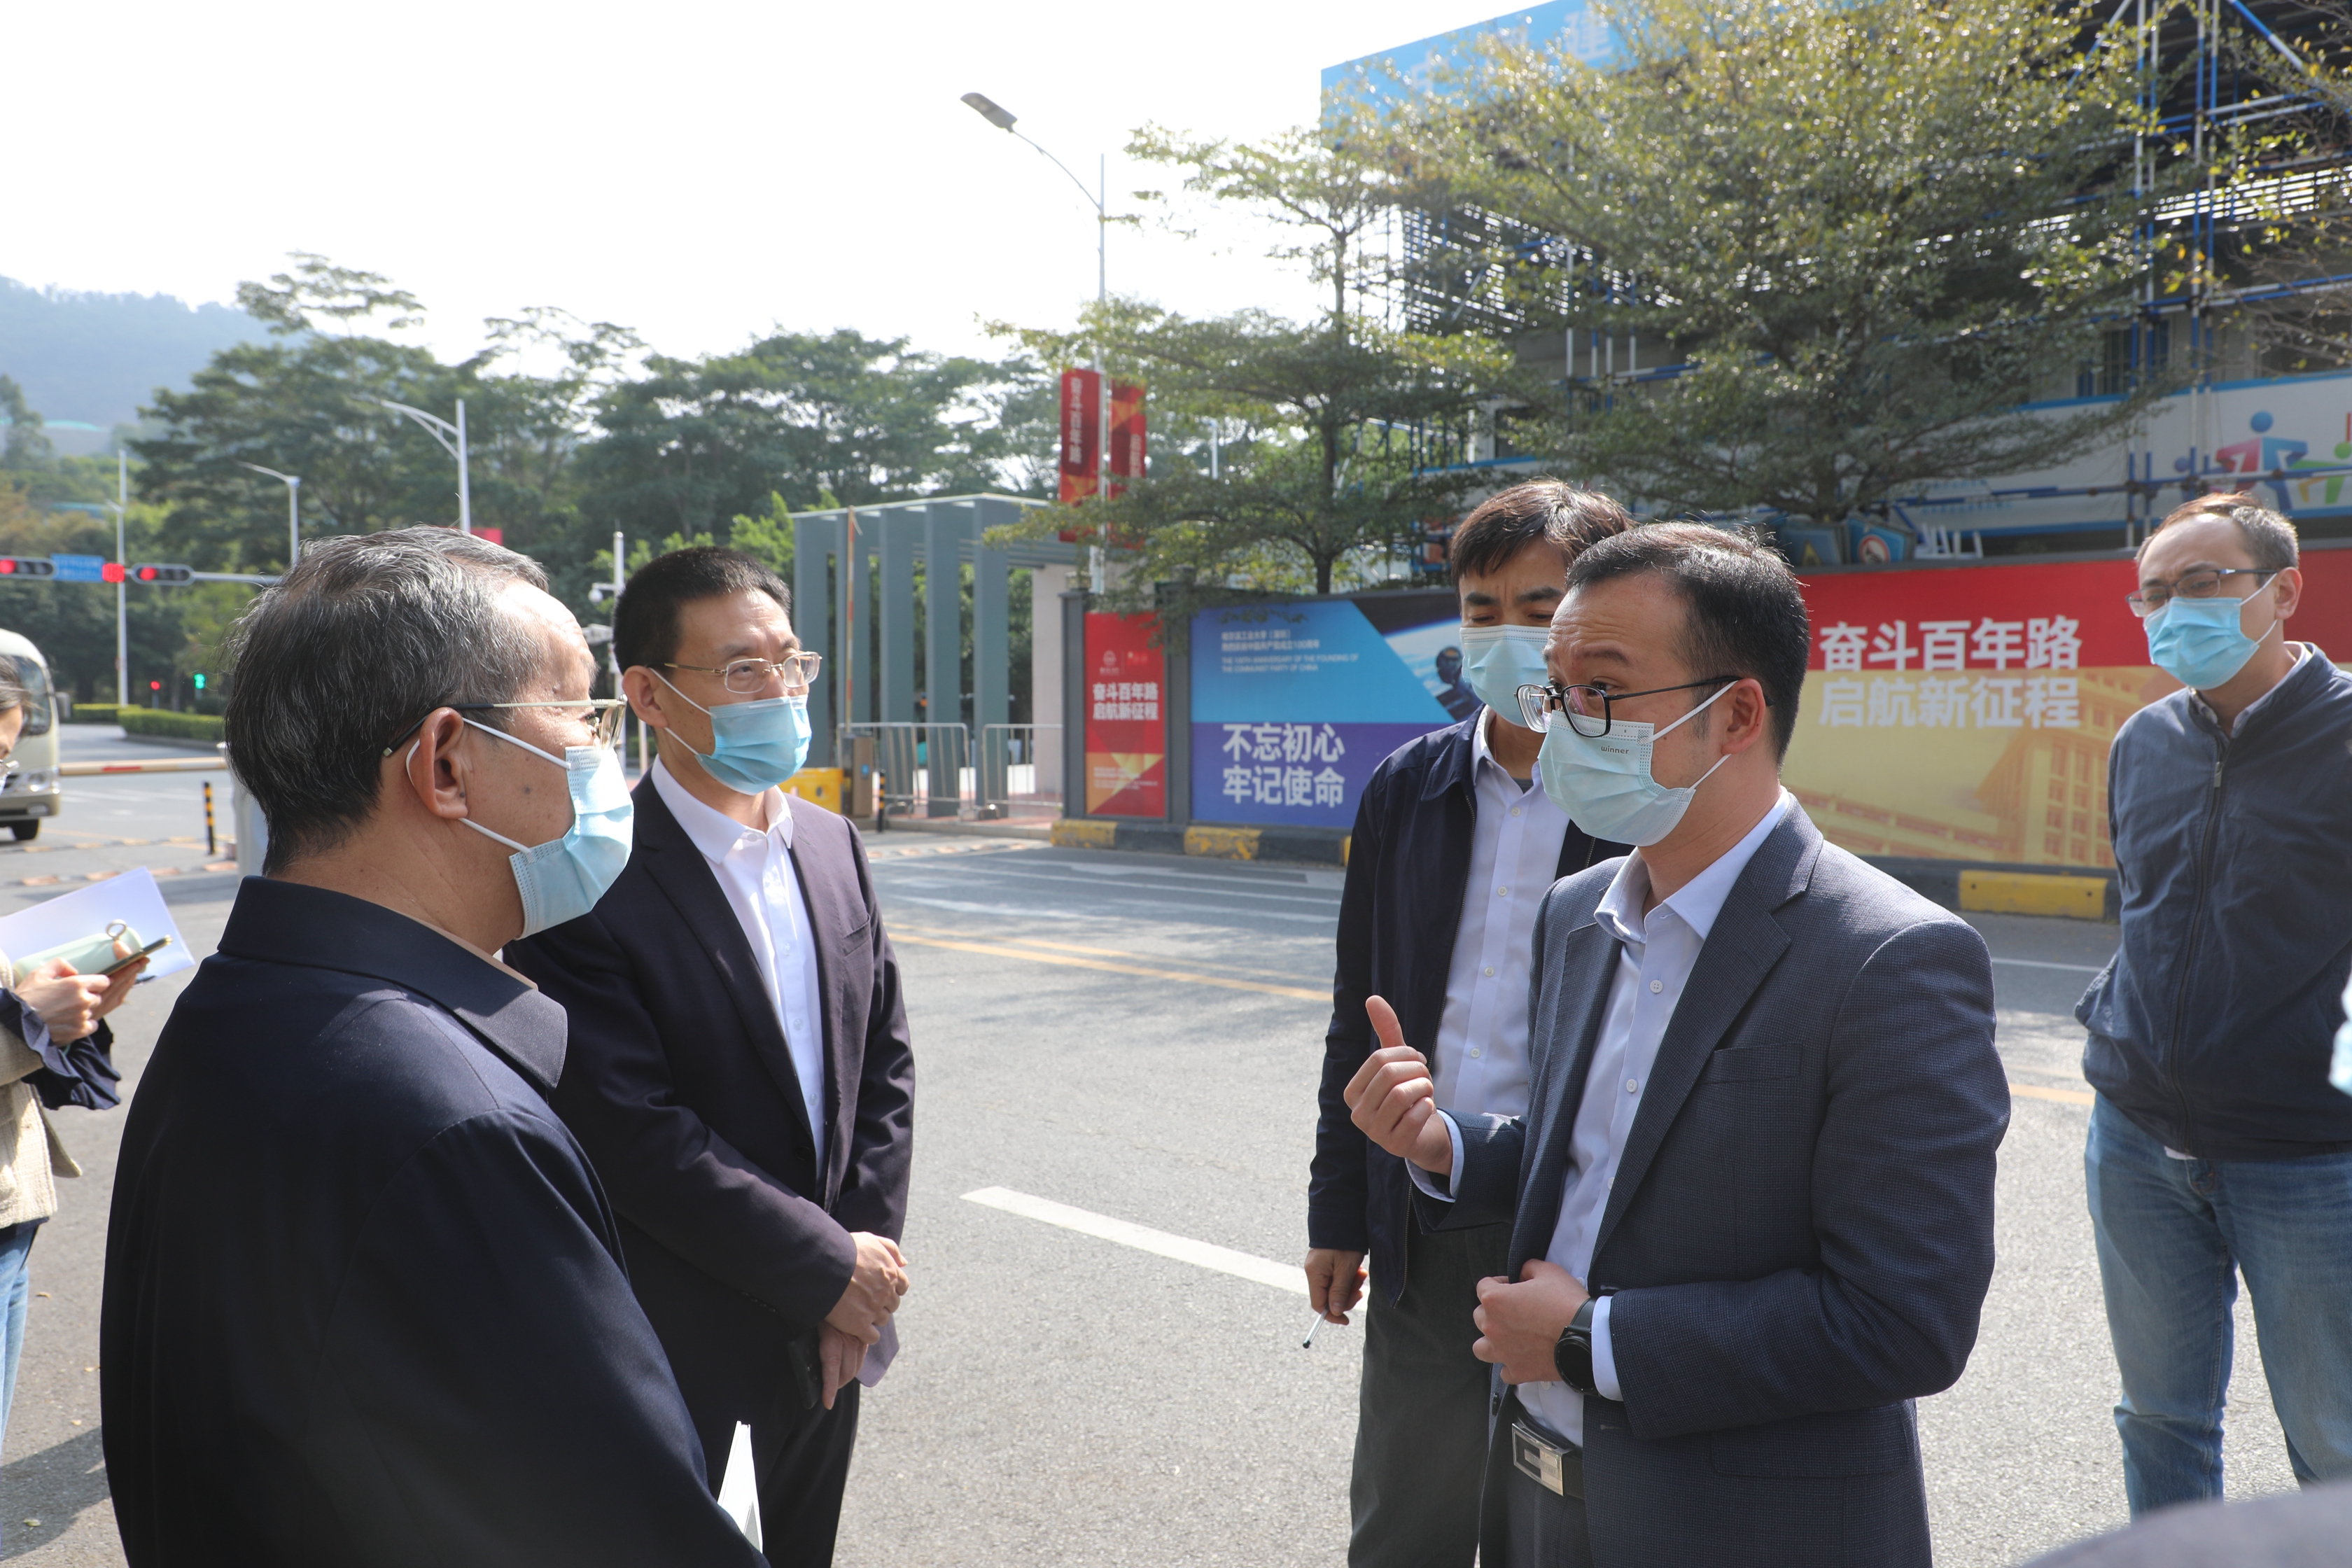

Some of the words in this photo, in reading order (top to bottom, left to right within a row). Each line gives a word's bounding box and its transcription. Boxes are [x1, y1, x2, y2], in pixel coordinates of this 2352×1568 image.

[1819, 615, 2082, 672] 奋斗百年路
[1819, 676, 2081, 729] 启航新征程
[1222, 723, 1345, 763] 不忘初心
[1601, 746, 1629, 754] winner
[1222, 765, 1345, 808] 牢记使命
